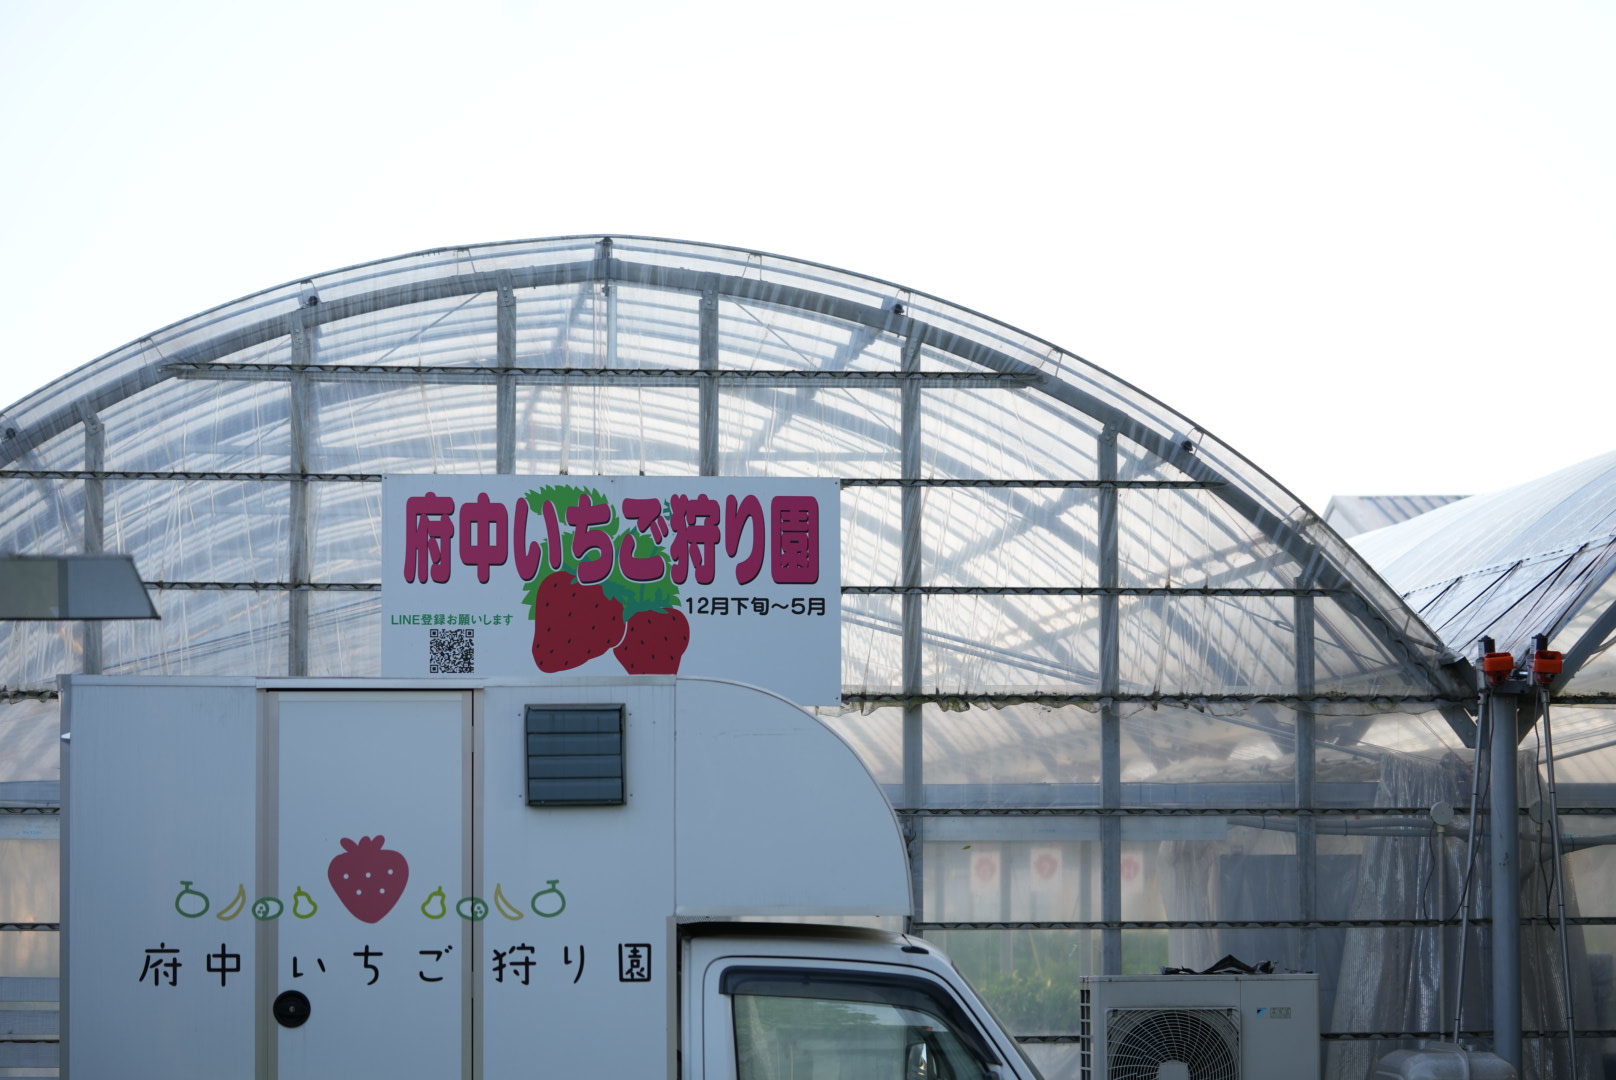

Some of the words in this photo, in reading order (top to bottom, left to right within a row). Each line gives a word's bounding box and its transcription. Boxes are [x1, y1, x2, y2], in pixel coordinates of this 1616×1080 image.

[403, 491, 819, 585] 府中いちご狩り園
[391, 613, 514, 627] LINE登録お願いします
[139, 942, 652, 987] 府中いちご狩り園
